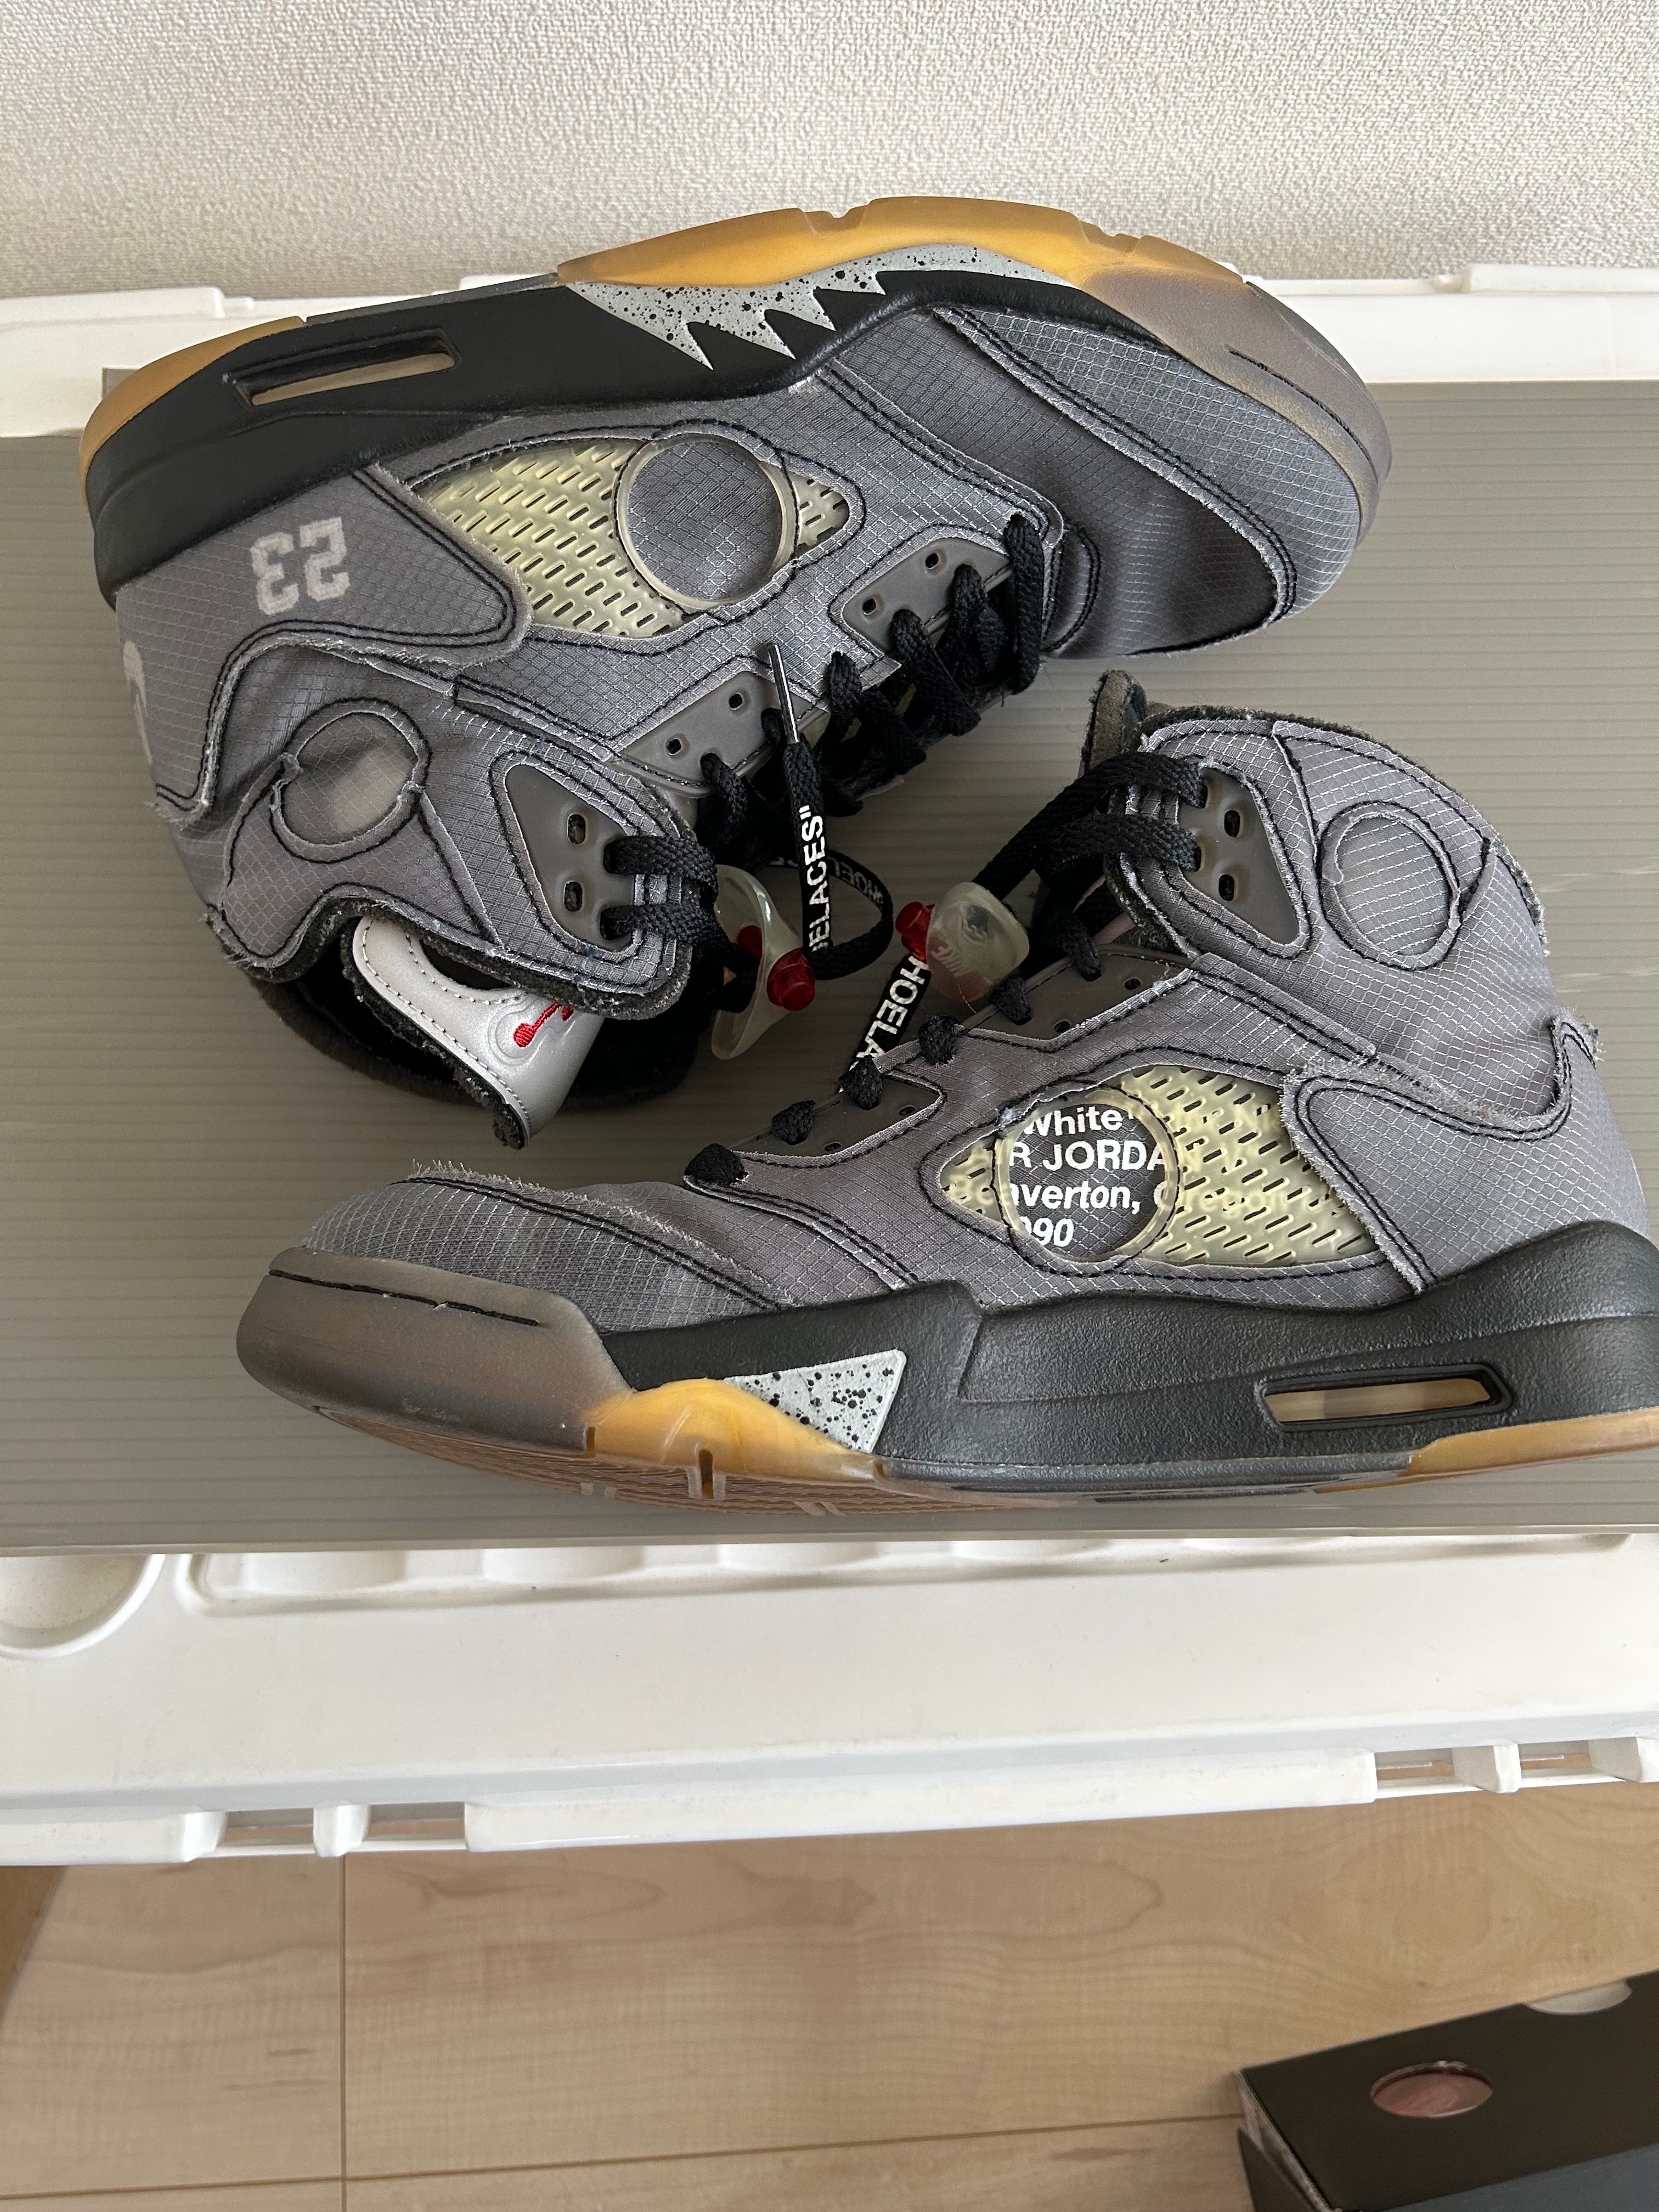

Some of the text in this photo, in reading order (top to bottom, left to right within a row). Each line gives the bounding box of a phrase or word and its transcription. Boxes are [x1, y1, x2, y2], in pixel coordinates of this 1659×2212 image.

[250, 516, 351, 616] 23
[799, 805, 830, 952] ELACES"
[849, 956, 929, 1071] HOELA
[1009, 1139, 1165, 1171] R JORDA
